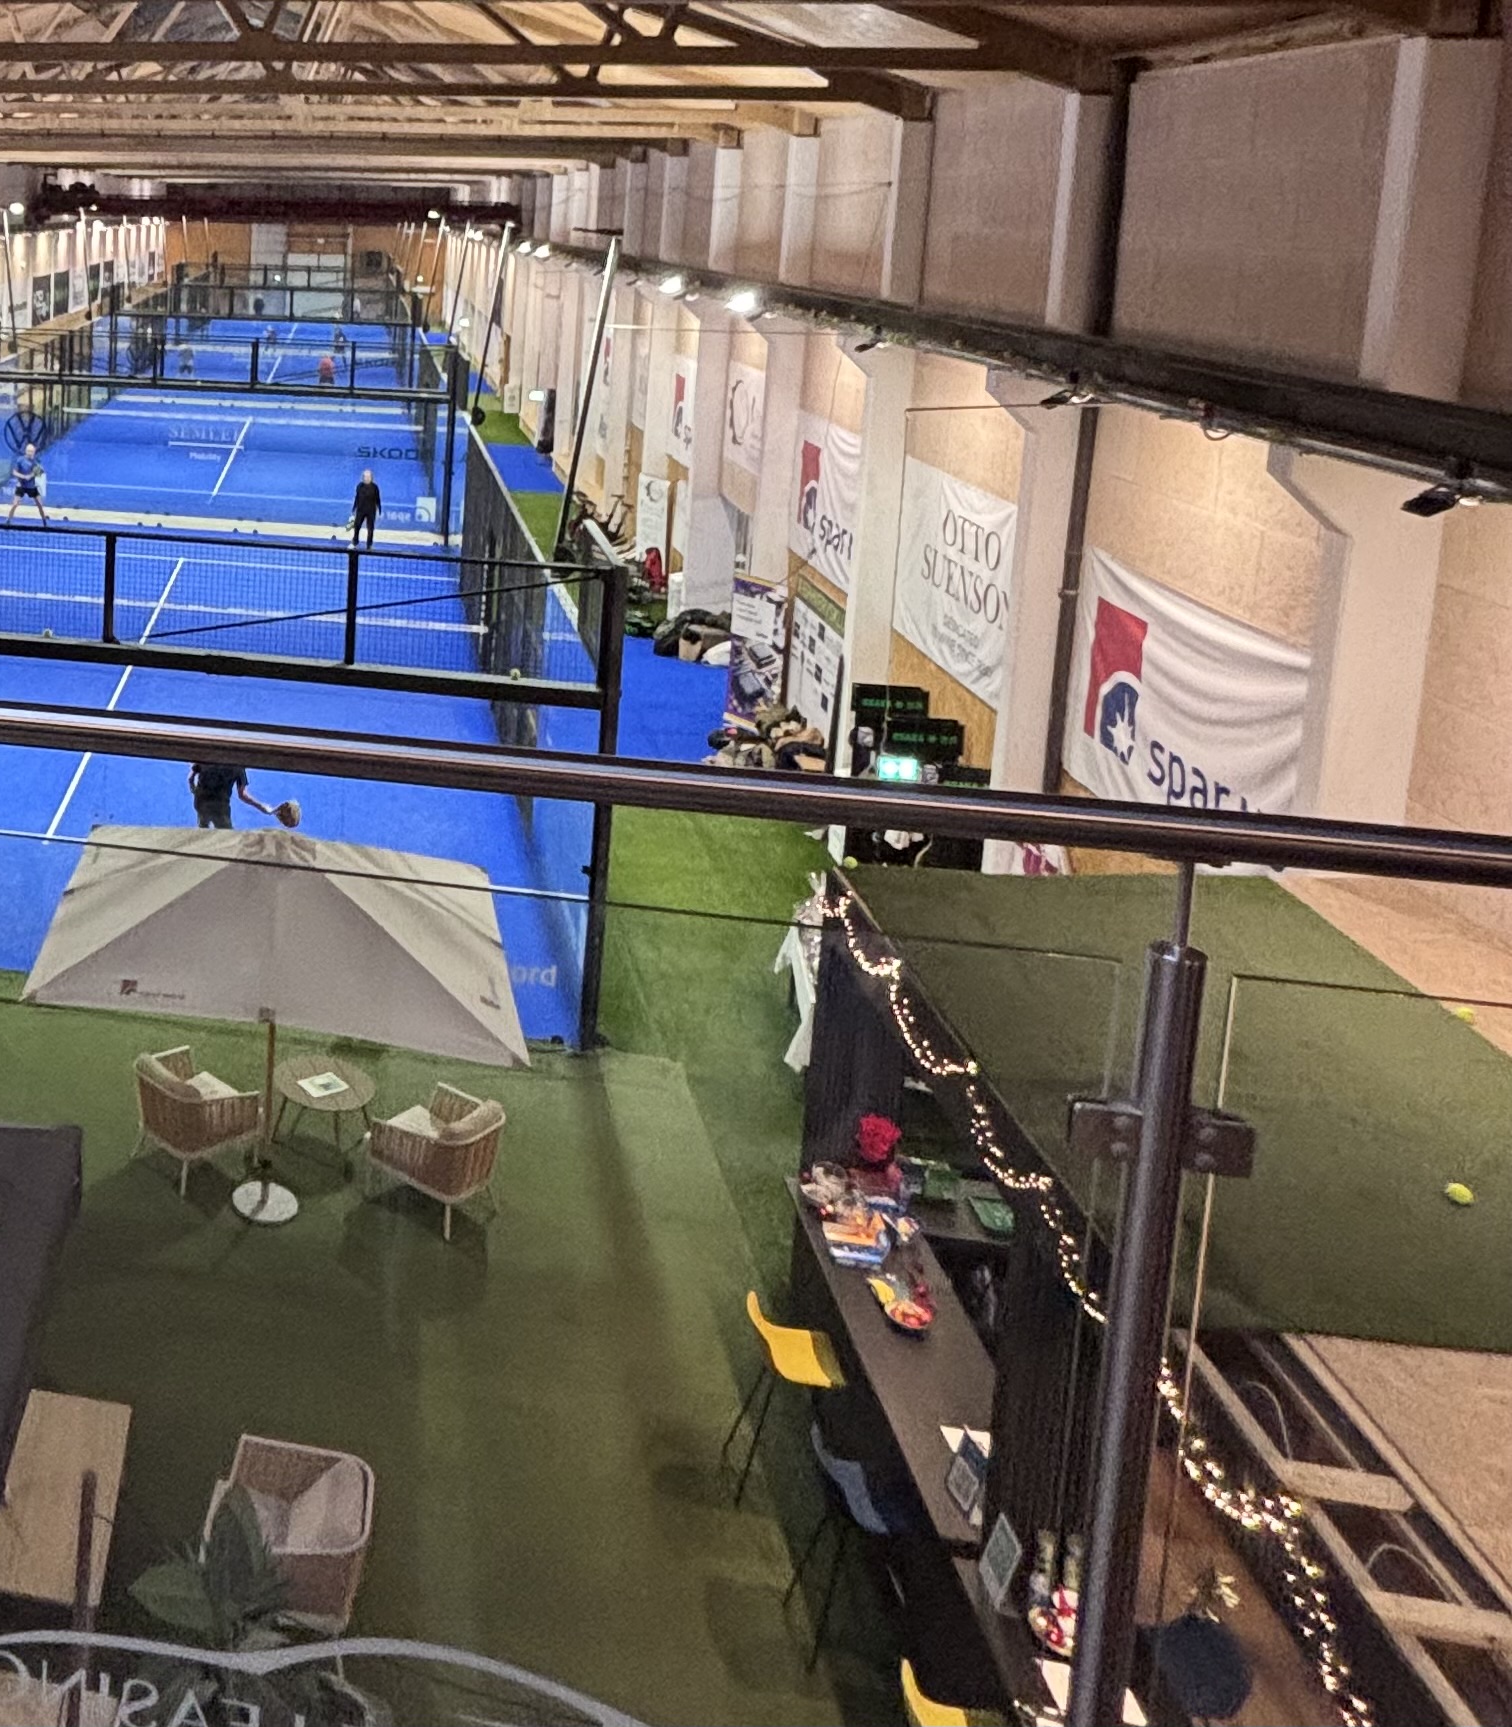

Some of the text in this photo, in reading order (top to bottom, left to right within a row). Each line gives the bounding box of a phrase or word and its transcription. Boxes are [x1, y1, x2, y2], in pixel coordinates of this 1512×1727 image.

[356, 446, 421, 461] SKOD
[943, 508, 1002, 572] OTTO
[510, 964, 558, 988] ord
